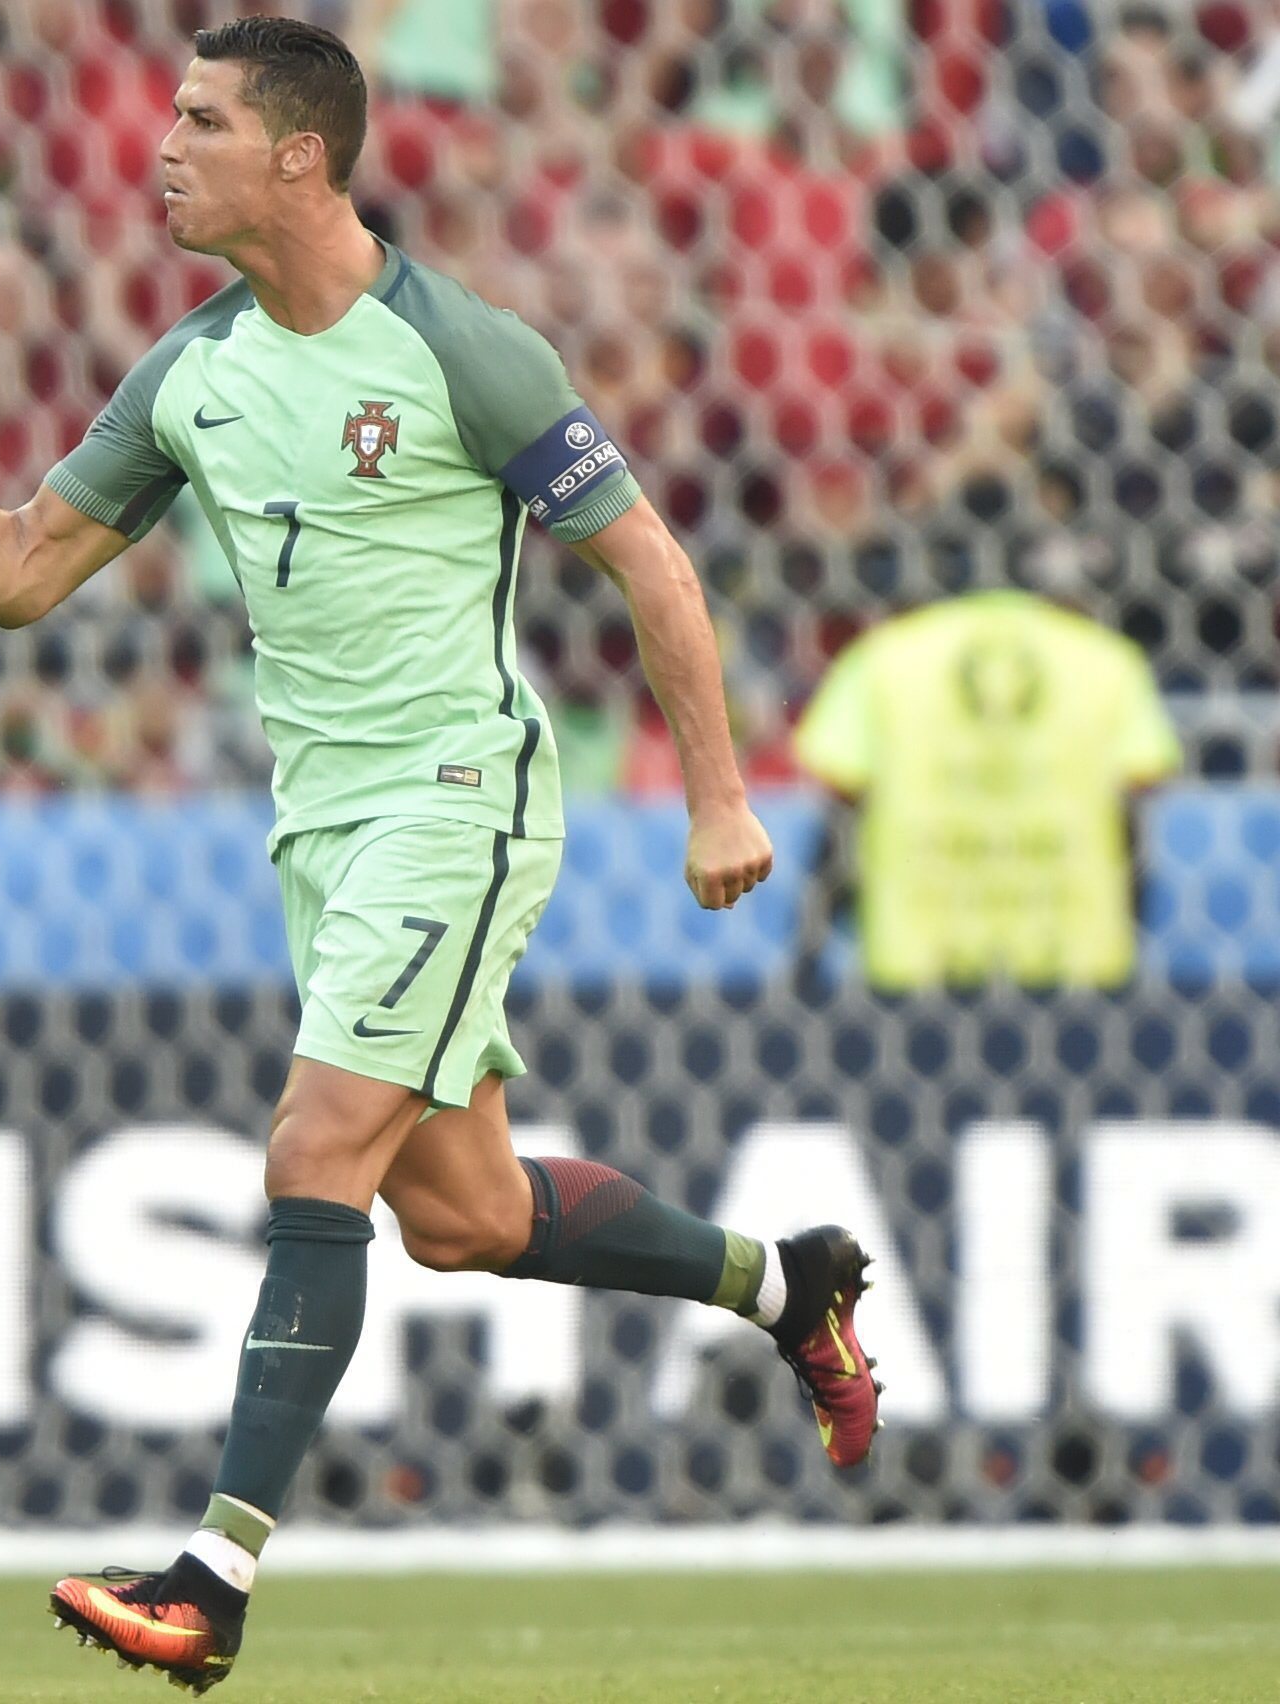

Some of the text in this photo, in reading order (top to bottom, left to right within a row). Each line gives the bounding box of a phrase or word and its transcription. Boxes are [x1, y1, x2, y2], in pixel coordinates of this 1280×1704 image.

[552, 475, 576, 498] NO
[574, 459, 595, 478] TO
[262, 500, 301, 588] 7
[378, 915, 450, 1009] 7
